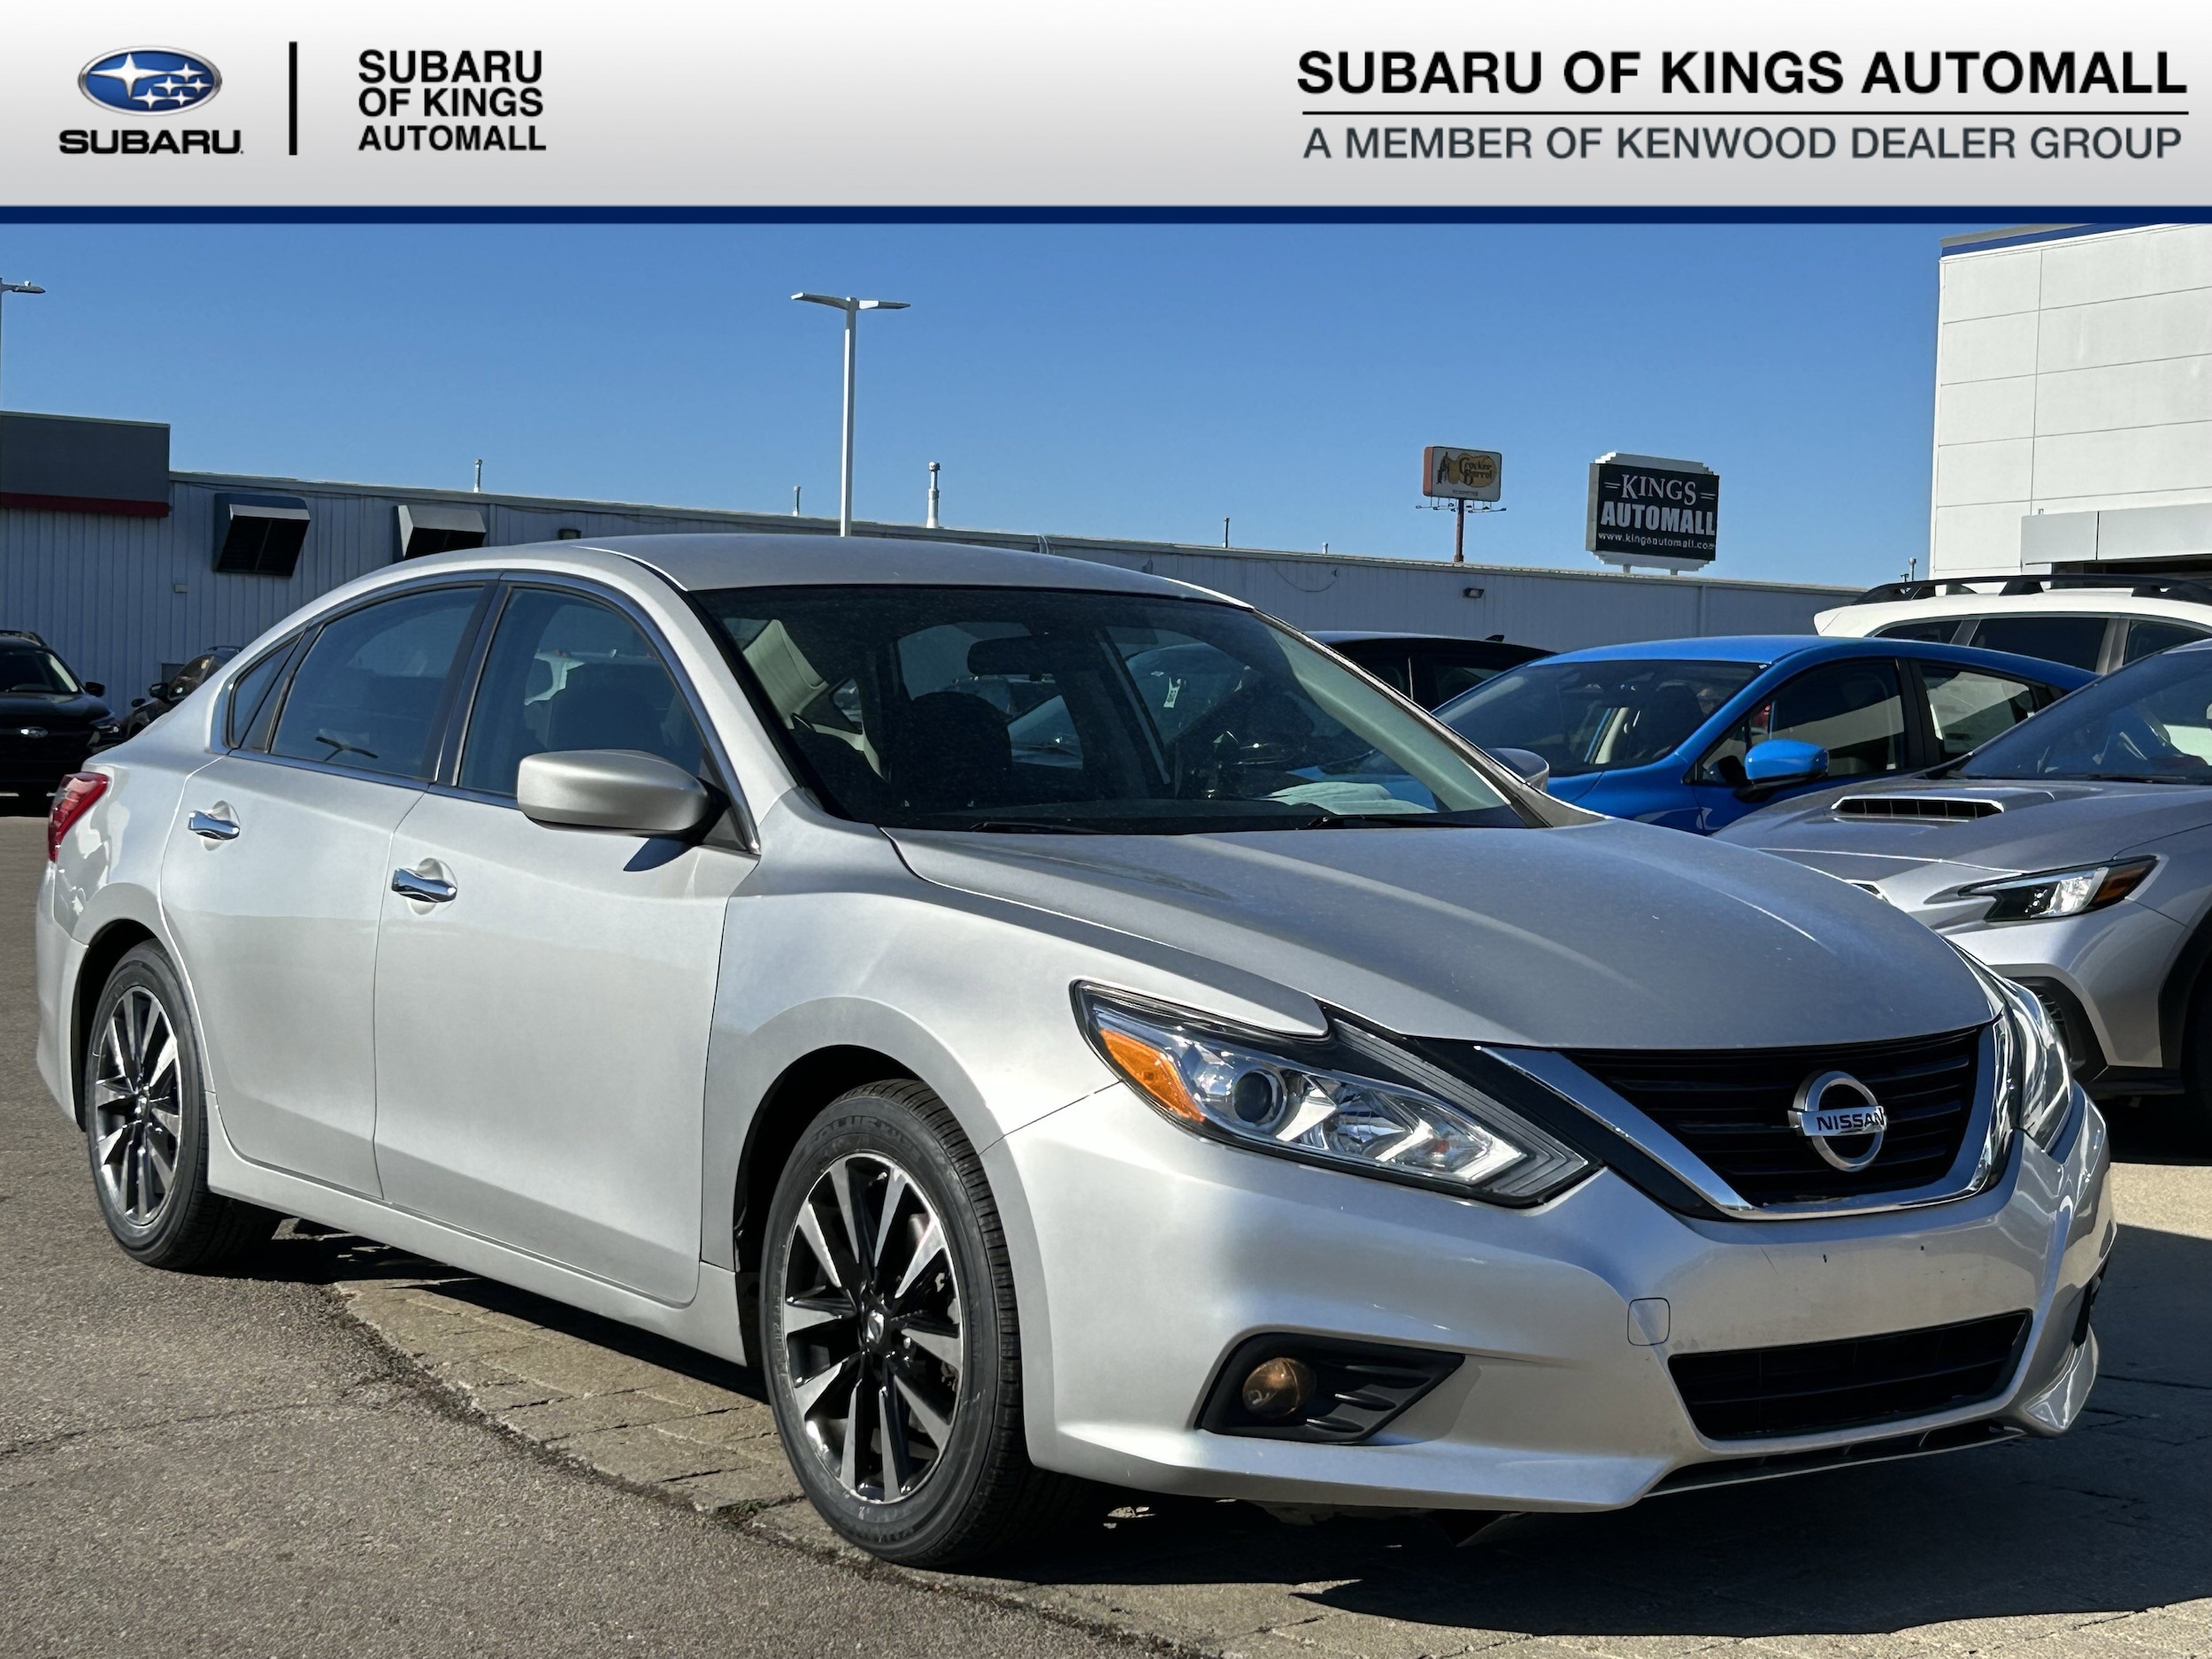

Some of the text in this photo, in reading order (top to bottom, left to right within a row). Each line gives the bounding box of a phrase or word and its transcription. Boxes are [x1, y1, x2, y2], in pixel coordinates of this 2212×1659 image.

[1621, 473, 1697, 506] KINGS
[1600, 500, 1716, 536] AUTOMALL
[1816, 1108, 1885, 1131] NISSAN
